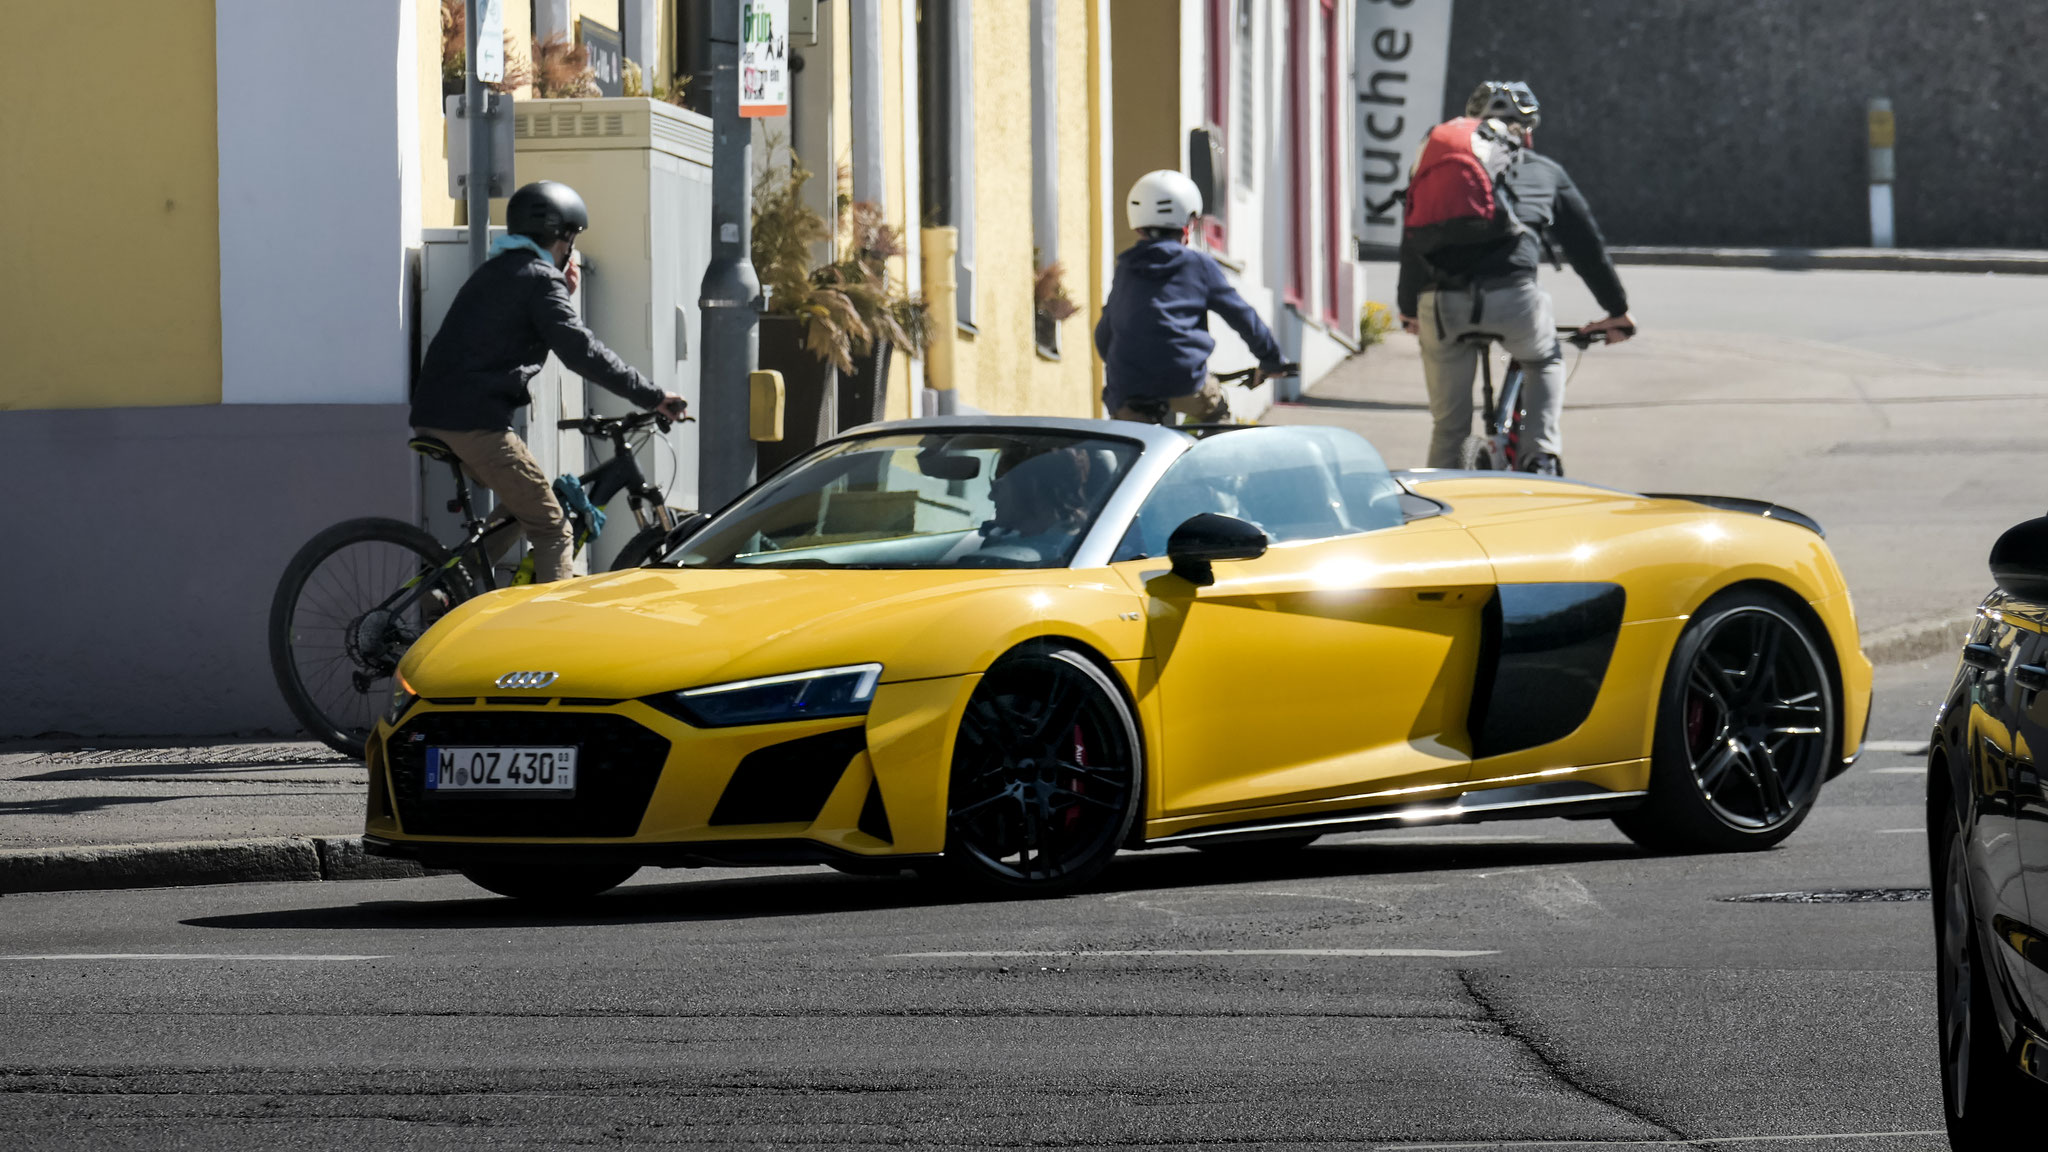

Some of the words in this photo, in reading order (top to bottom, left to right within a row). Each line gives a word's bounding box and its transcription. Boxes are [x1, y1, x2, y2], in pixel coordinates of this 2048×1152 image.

[744, 3, 771, 42] Grün
[439, 752, 454, 784] M
[471, 752, 500, 785] OZ
[507, 752, 554, 785] 430
